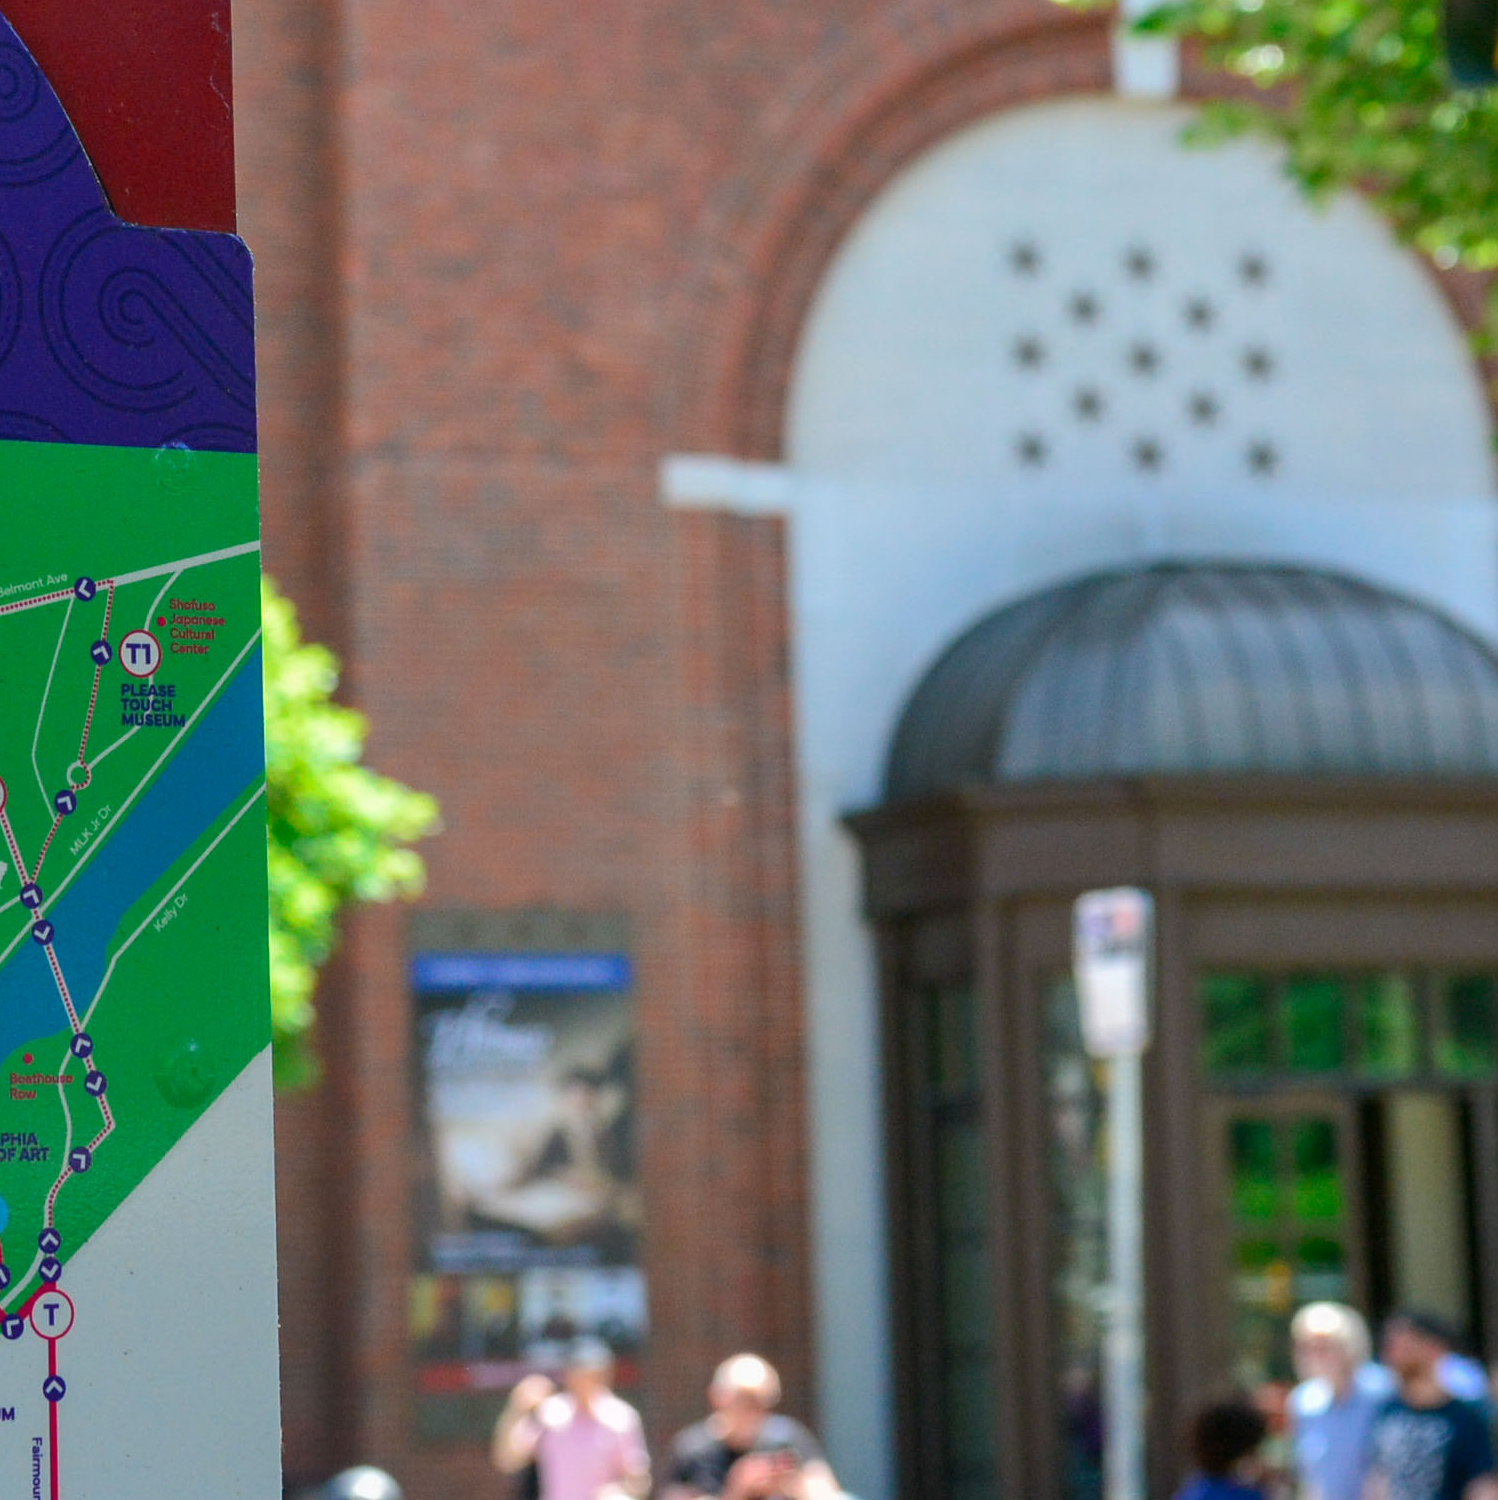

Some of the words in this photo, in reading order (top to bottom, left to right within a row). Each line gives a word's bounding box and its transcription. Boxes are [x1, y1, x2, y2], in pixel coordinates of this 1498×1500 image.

[46, 573, 68, 586] Ave
[170, 599, 215, 611] Shofuso
[171, 615, 225, 628] Japanese
[171, 629, 215, 640] Cultural
[125, 643, 151, 665] T1
[171, 643, 209, 655] Center
[121, 684, 175, 698] PLEASE
[121, 699, 172, 712] TOUCH
[121, 714, 186, 728] MUSEUM
[69, 828, 93, 855] MLK
[90, 818, 101, 831] Jr
[98, 804, 112, 820] Dr
[153, 906, 178, 932] Kelly
[174, 893, 188, 909] Dr
[9, 1073, 73, 1085] Boathouse
[9, 1088, 37, 1100] Row
[19, 1147, 49, 1161] ART
[44, 1304, 60, 1324] T
